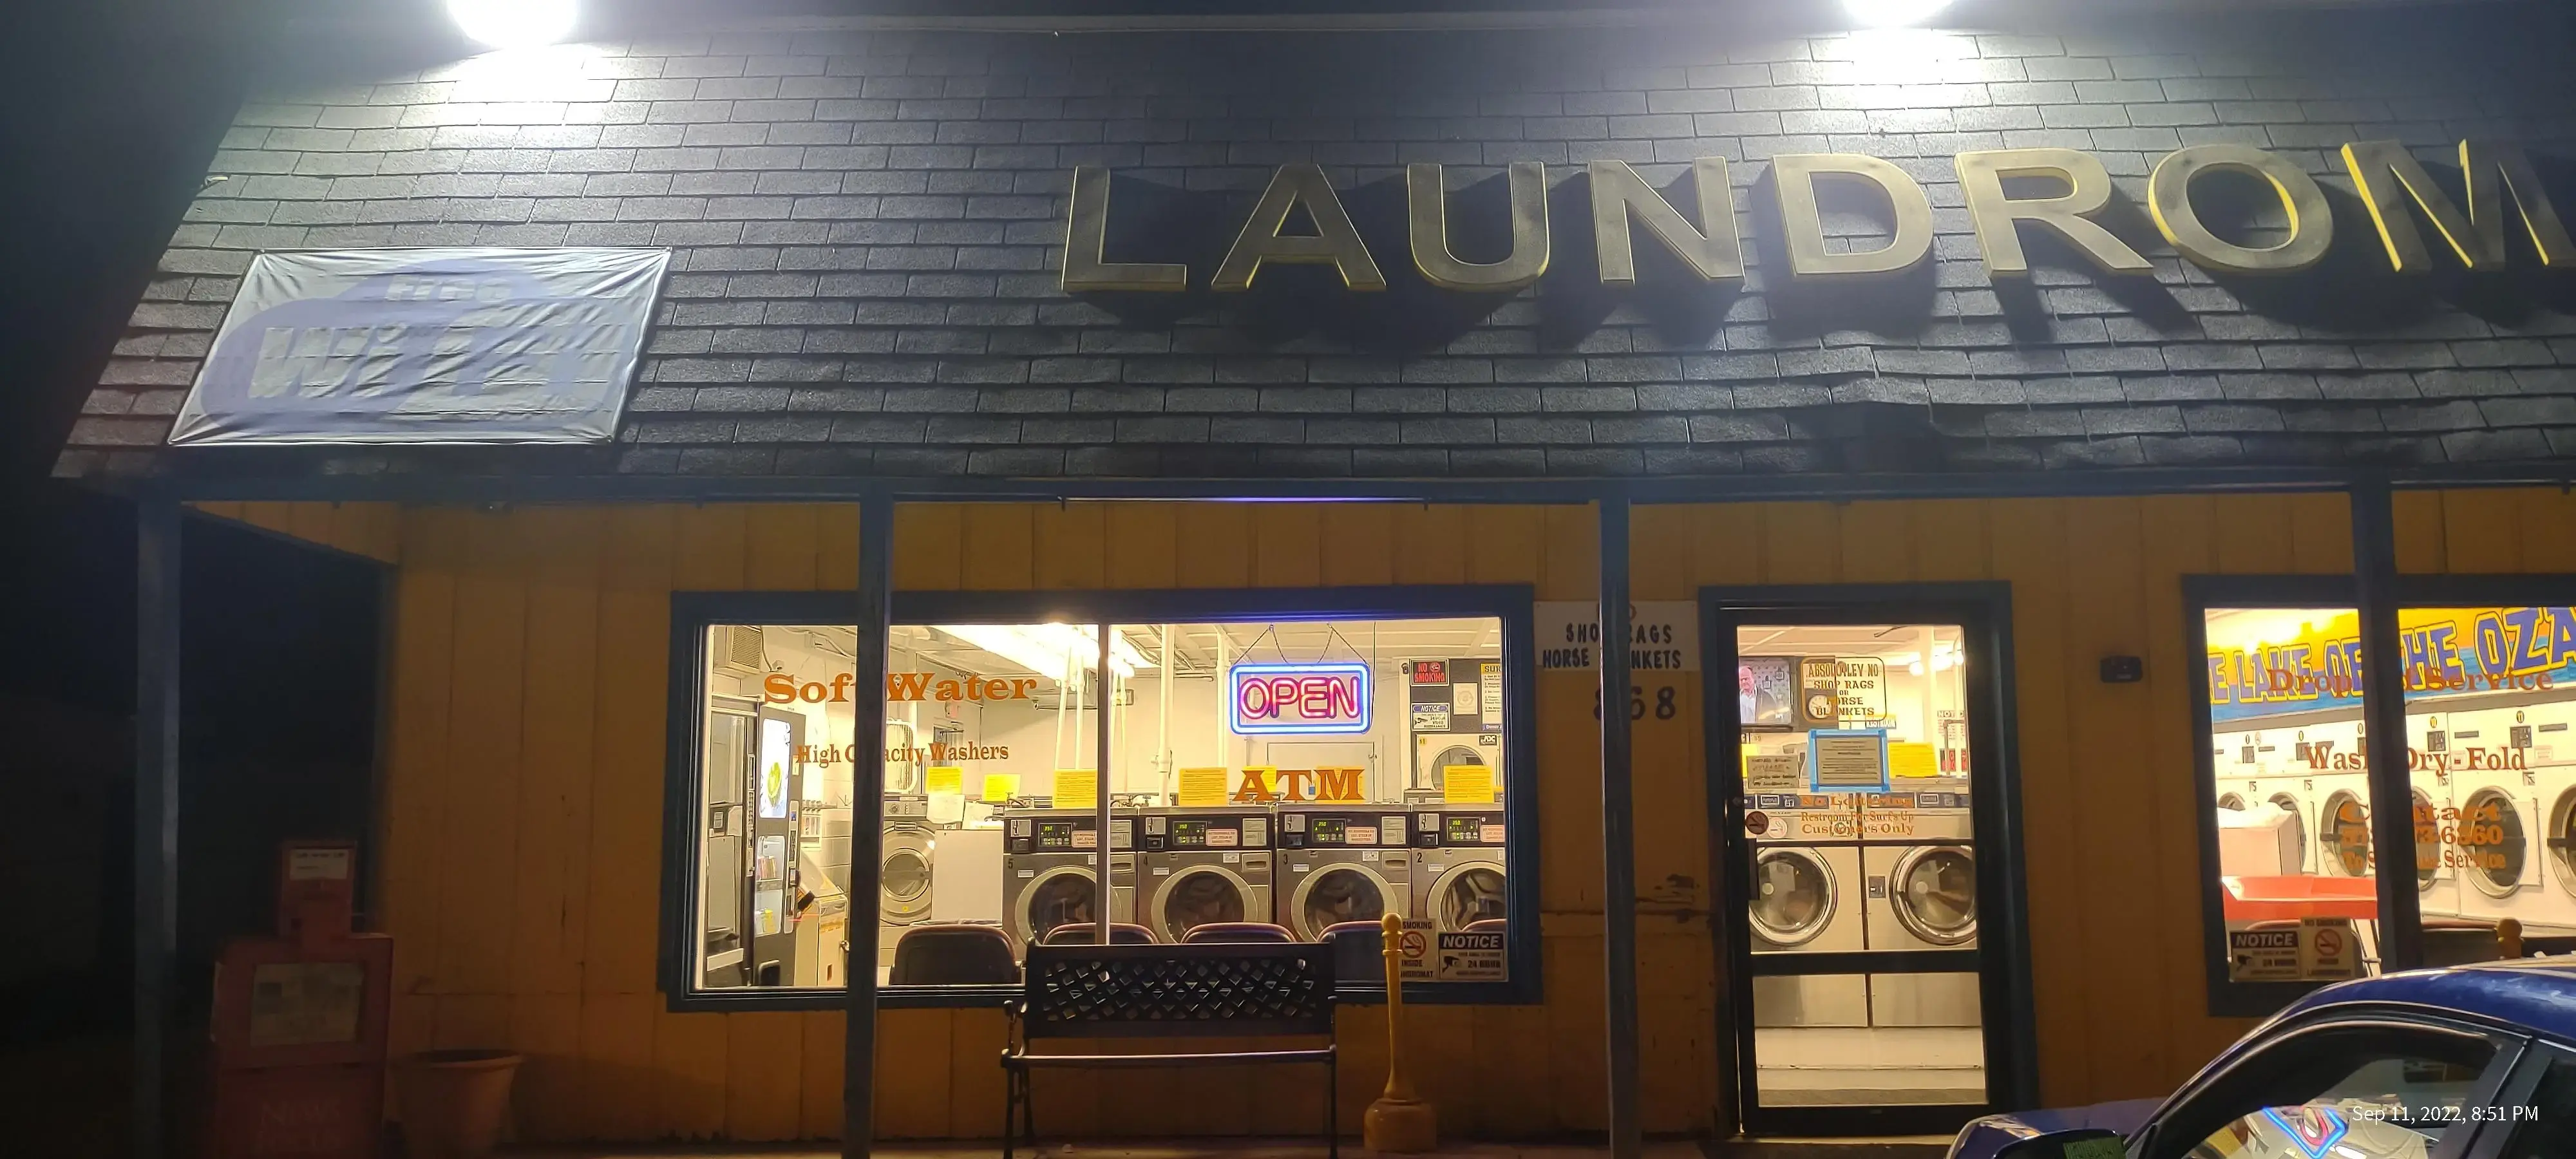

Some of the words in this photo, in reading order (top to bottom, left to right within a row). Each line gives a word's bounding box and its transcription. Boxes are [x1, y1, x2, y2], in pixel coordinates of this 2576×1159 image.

[1061, 139, 2576, 294] LAUNDROM
[1566, 623, 1600, 643] SHO
[1629, 624, 1672, 644] AGS
[1542, 648, 1590, 669] HORSE
[1629, 650, 1681, 670] NKETS
[2233, 643, 2318, 702] LAKE
[2400, 622, 2464, 691] HE
[1868, 663, 1879, 677] NO
[764, 672, 857, 704] Sof
[887, 672, 1037, 702] Water
[1844, 680, 1874, 689] RAGS
[2268, 668, 2353, 698] Drop
[2427, 666, 2553, 692] Service
[1238, 675, 1361, 721] OPEN
[1815, 707, 1875, 715] BLNKETS
[796, 743, 841, 768] High
[845, 742, 925, 766] Cacity
[928, 740, 1009, 763] Washers
[1233, 768, 1366, 801] ATM
[1880, 823, 1915, 835] Only
[1008, 858, 1014, 869] 5
[1417, 853, 1423, 863] 2
[1403, 921, 1432, 930] SMOKING
[1442, 935, 1500, 948] NOTICE
[2236, 933, 2293, 947] NOTICE
